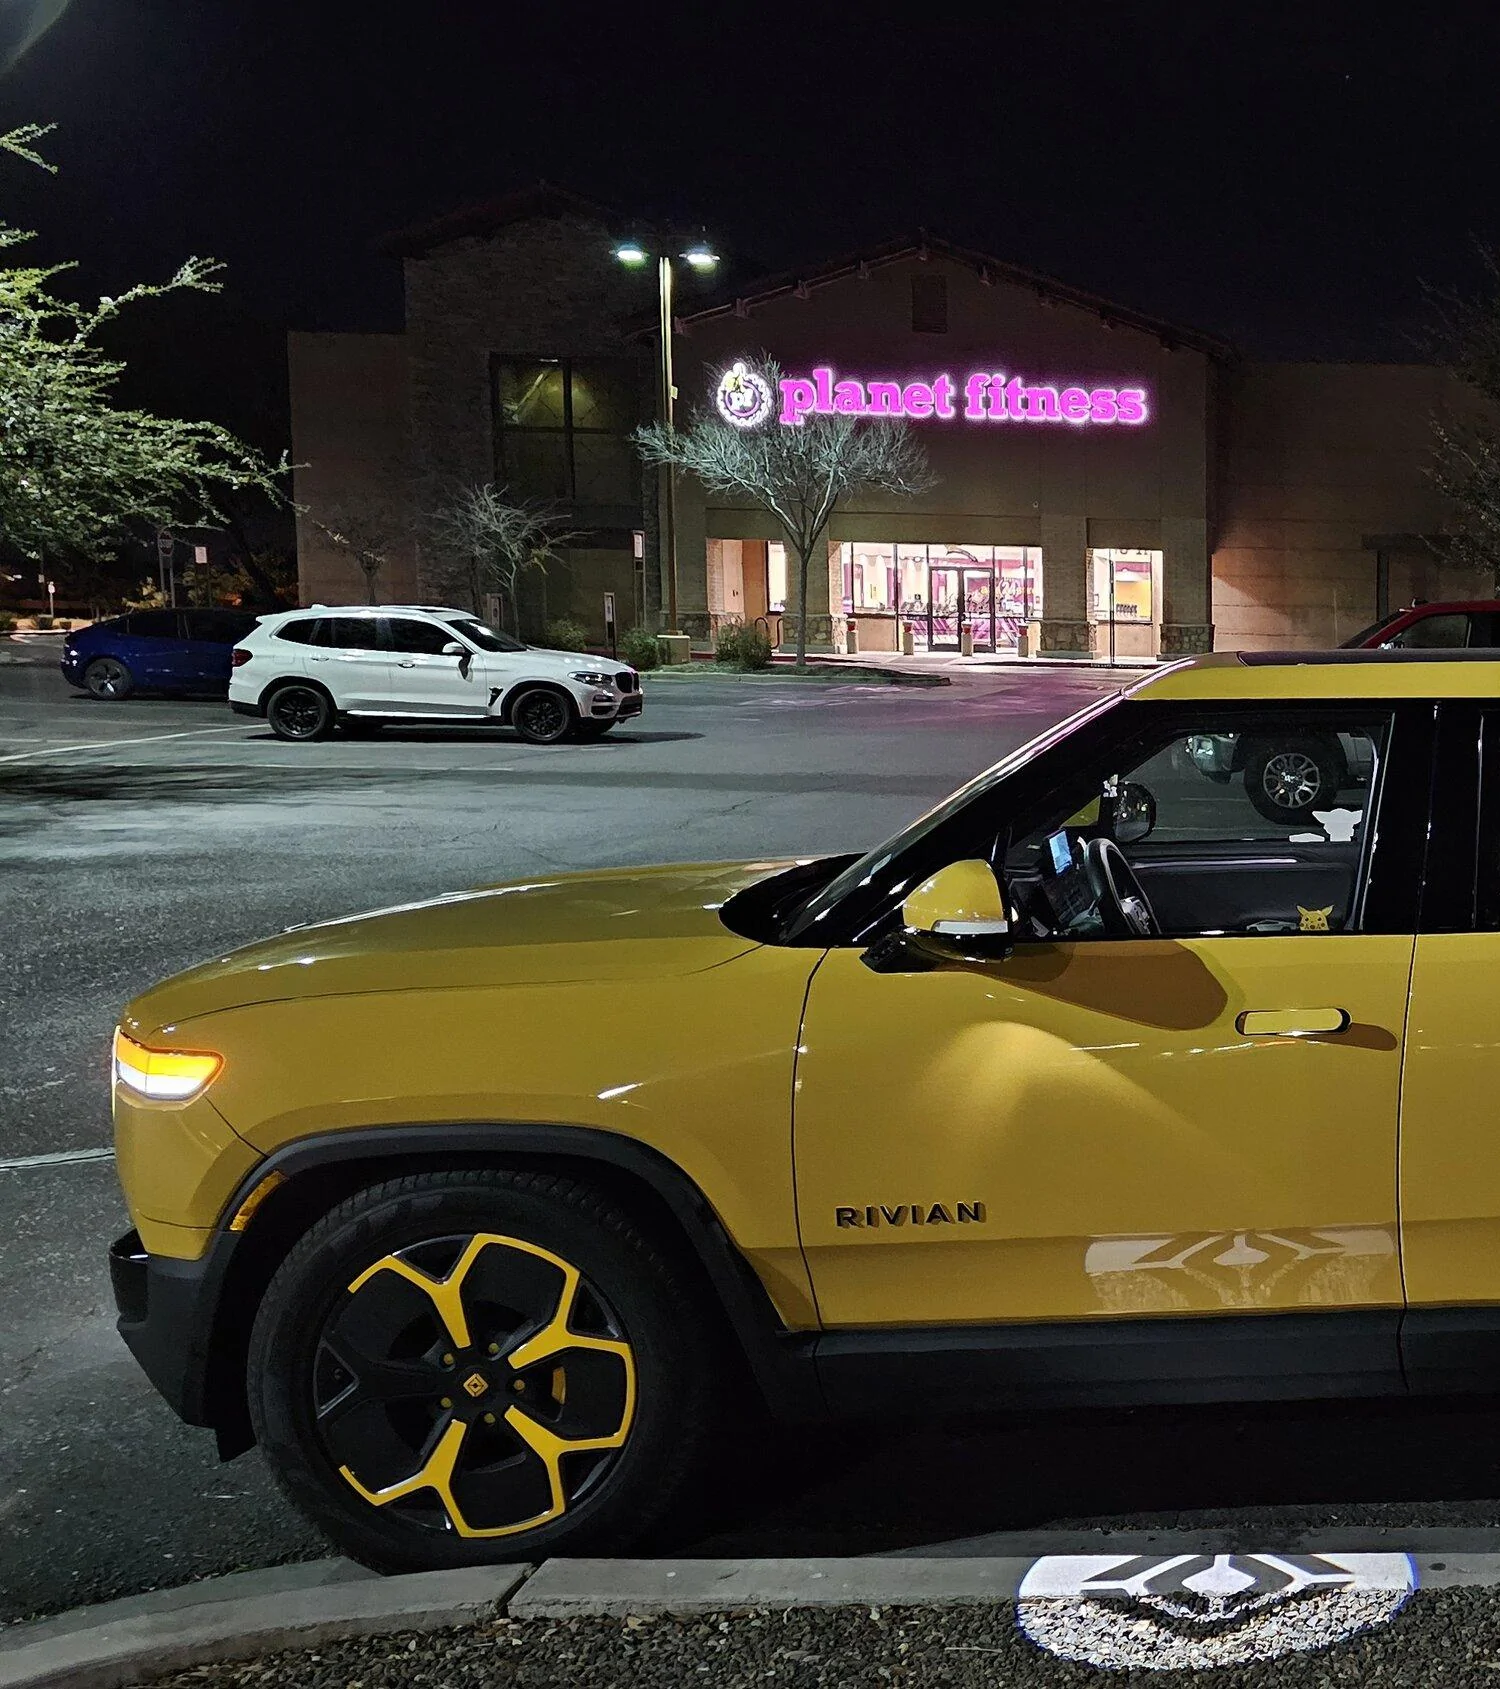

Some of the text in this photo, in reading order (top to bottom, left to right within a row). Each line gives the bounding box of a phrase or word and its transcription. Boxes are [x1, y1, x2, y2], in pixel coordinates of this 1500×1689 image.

[779, 368, 1150, 425] planet fitness
[835, 1201, 981, 1229] RIVIAN
